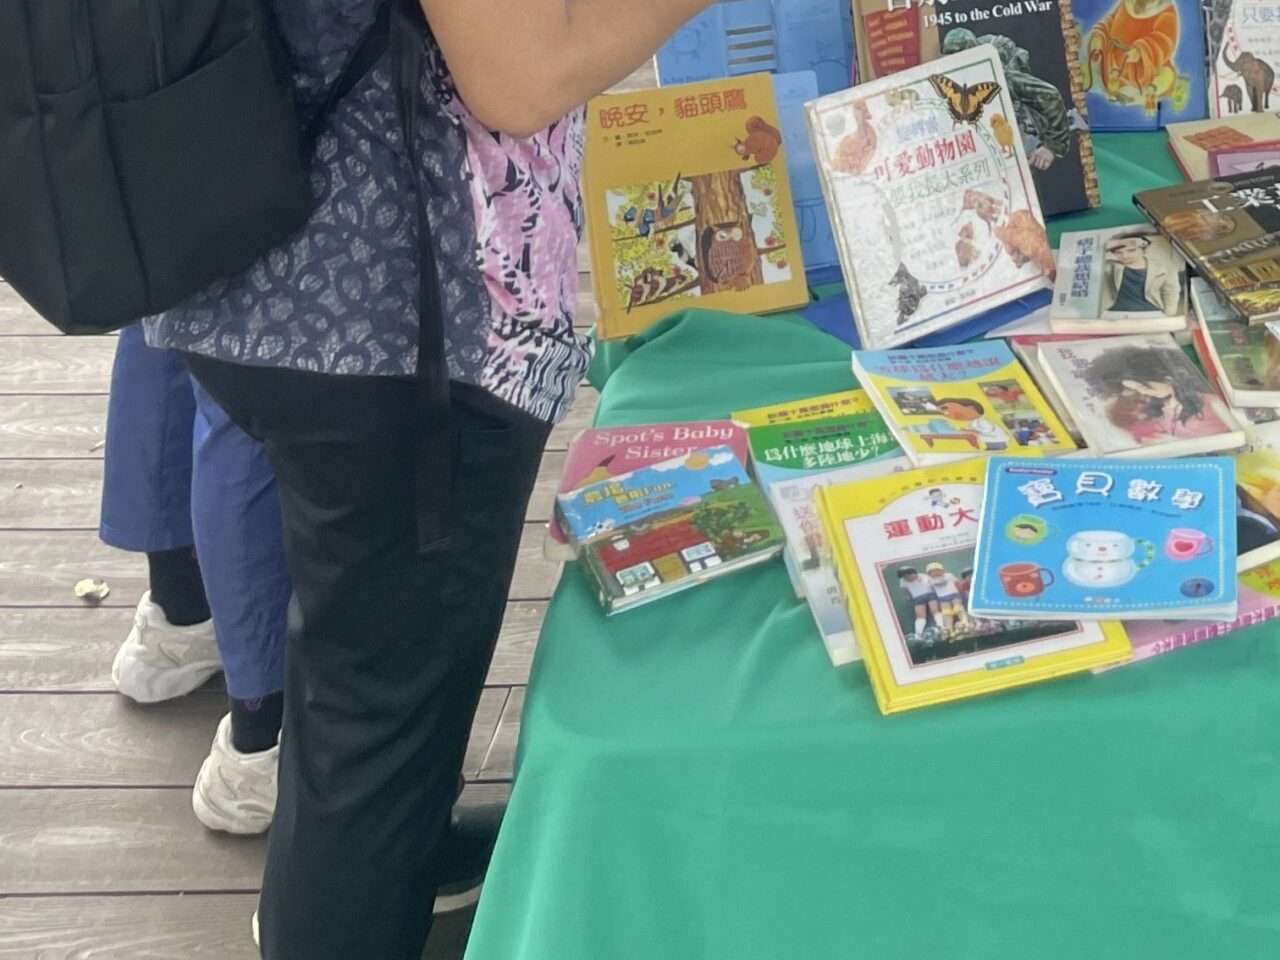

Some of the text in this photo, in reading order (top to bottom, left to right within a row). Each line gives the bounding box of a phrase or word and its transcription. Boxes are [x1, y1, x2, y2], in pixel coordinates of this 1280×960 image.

[923, 0, 1053, 29] 1945 to the Cold War
[874, 129, 977, 183] 可愛動物園
[594, 425, 734, 447] Spot's Baby
[625, 445, 698, 460] Sister
